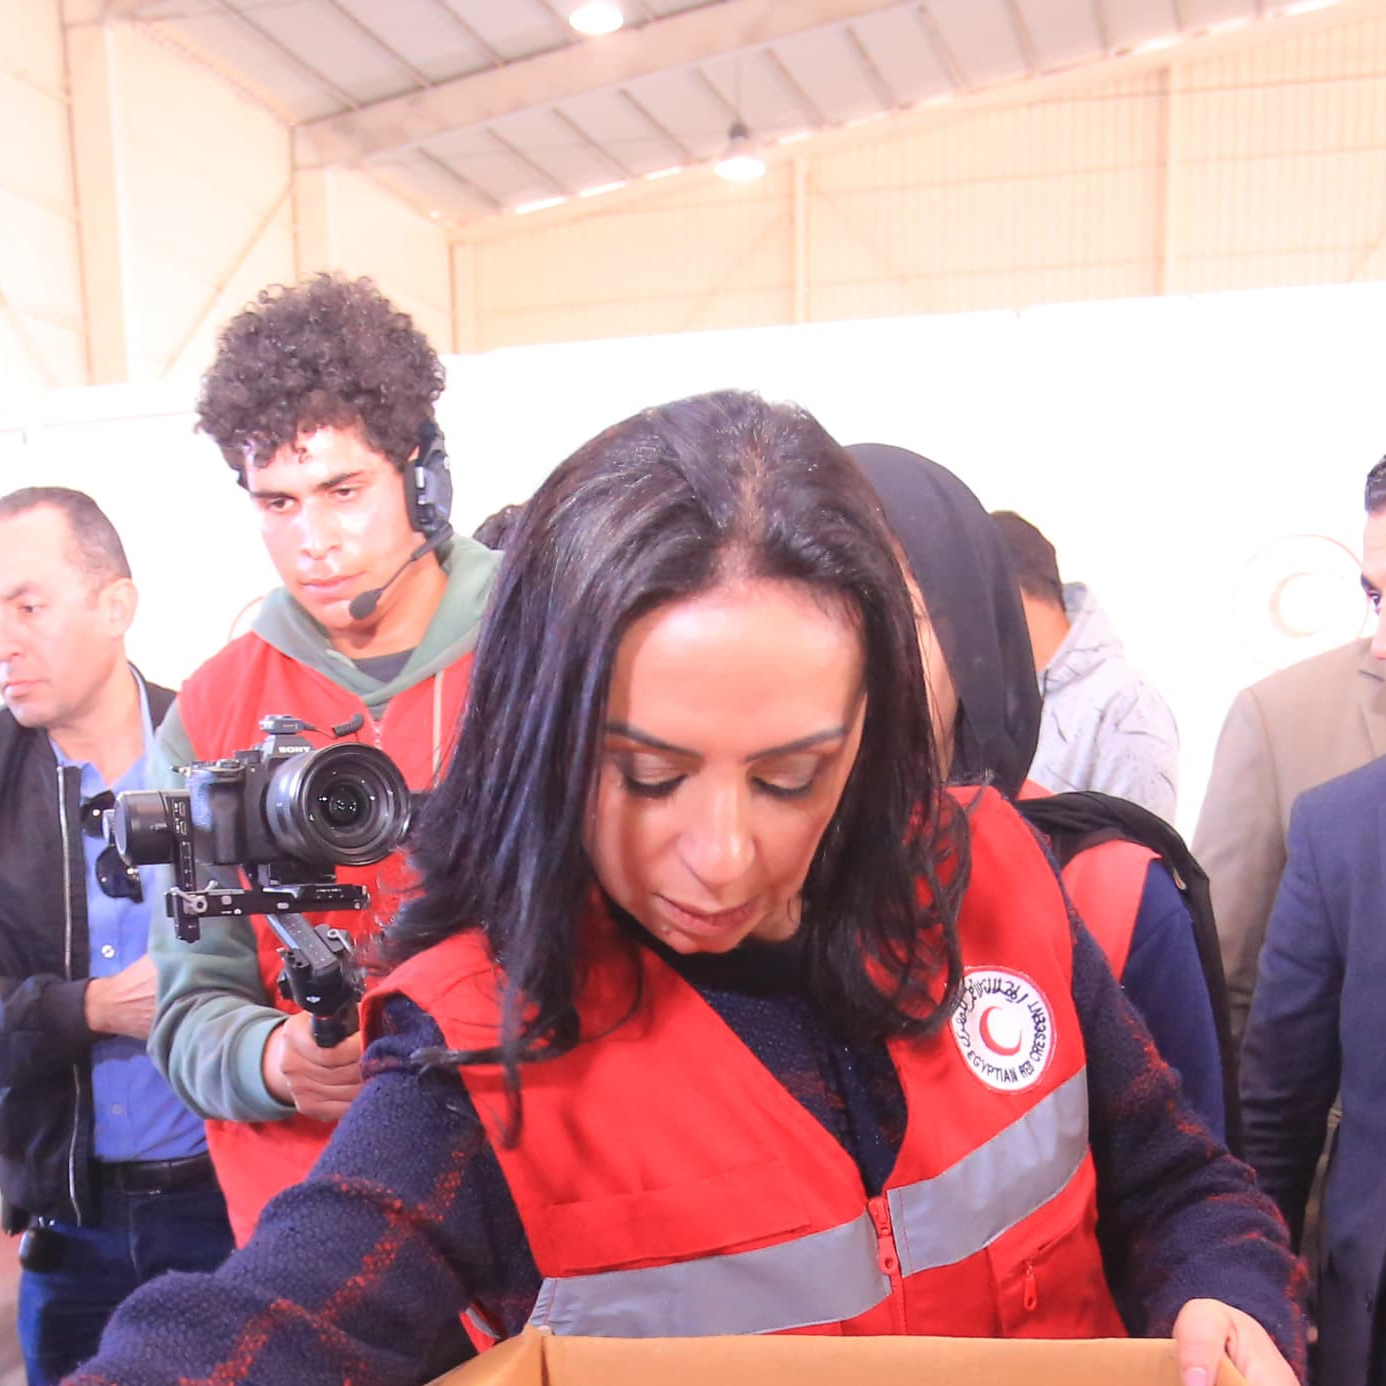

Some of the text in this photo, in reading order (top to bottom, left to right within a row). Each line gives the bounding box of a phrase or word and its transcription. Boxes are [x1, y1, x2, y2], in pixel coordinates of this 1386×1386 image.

[277, 745, 311, 754] SONY
[967, 1050, 1019, 1083] EGYPTIAN
[1027, 1001, 1047, 1063] CRESCENT
